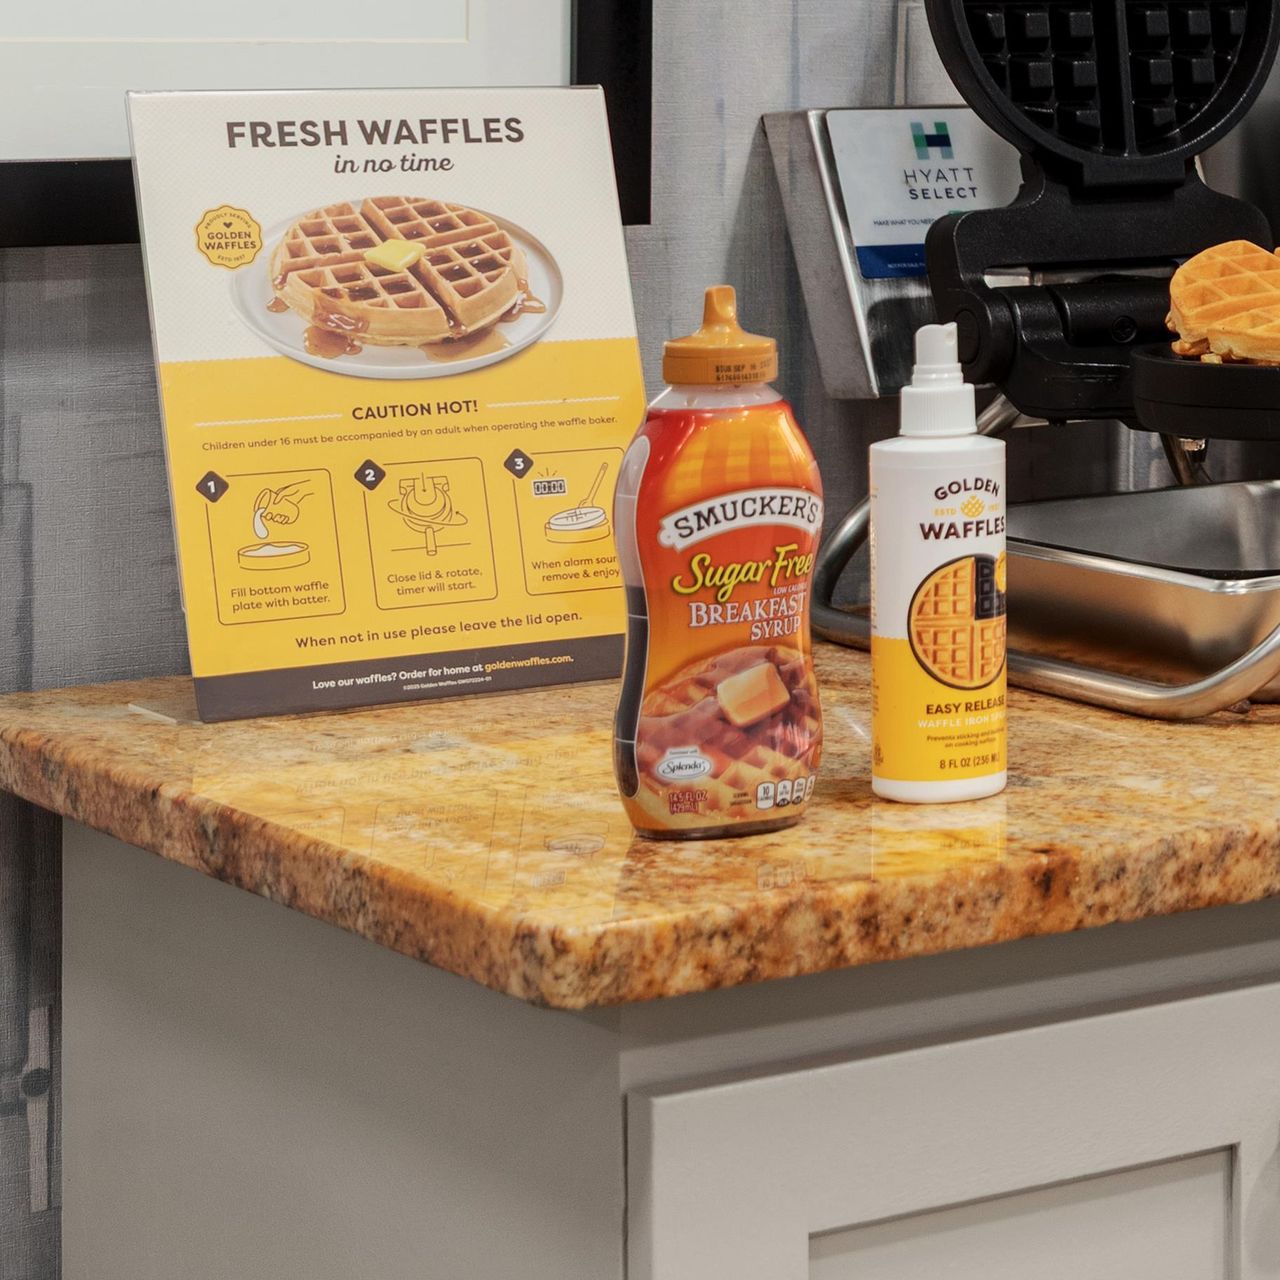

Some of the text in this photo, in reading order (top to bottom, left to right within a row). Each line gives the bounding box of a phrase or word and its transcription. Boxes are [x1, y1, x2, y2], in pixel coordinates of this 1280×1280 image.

[226, 117, 525, 148] FRESH WAFFLES
[334, 153, 454, 174] in no time
[903, 168, 974, 184] HYATT
[908, 187, 978, 200] SELECT
[207, 231, 252, 240] GOLDEN
[204, 241, 257, 250] WAFFLES
[352, 400, 478, 420] CAUTION HOT!
[202, 415, 618, 451] Children under 16 must be accompanied by an adult when operating the waffle baker.
[514, 458, 525, 470] 3
[365, 469, 376, 482] 2
[207, 480, 216, 493] 1
[934, 477, 1000, 500] GOLDEN
[674, 494, 818, 538] SMUCKER'S
[920, 516, 1005, 540] WAFFLES
[531, 559, 561, 570] When
[563, 556, 593, 567] alarm
[387, 572, 416, 584] Close
[418, 568, 432, 580] lid
[434, 569, 443, 579] &
[542, 572, 580, 583] remove
[582, 569, 591, 579] &
[673, 543, 814, 603] Sugar Free
[231, 580, 329, 598] Fill bottom waffle
[397, 579, 476, 596] timer will start.
[232, 594, 331, 614] plate with batter.
[689, 591, 807, 627] BREAKFAST
[295, 612, 583, 648] When not in use please leave the lid open.
[751, 616, 801, 641] SYRUP
[313, 654, 574, 690] Love our waffles? Order for home at goldenwaffles.com.
[926, 695, 1005, 715] EASY RELEASE
[918, 718, 961, 729] WAFFLE
[662, 761, 703, 776] Splenda
[939, 759, 946, 769] 8
[948, 759, 958, 769] FL
[960, 757, 971, 768] OZ
